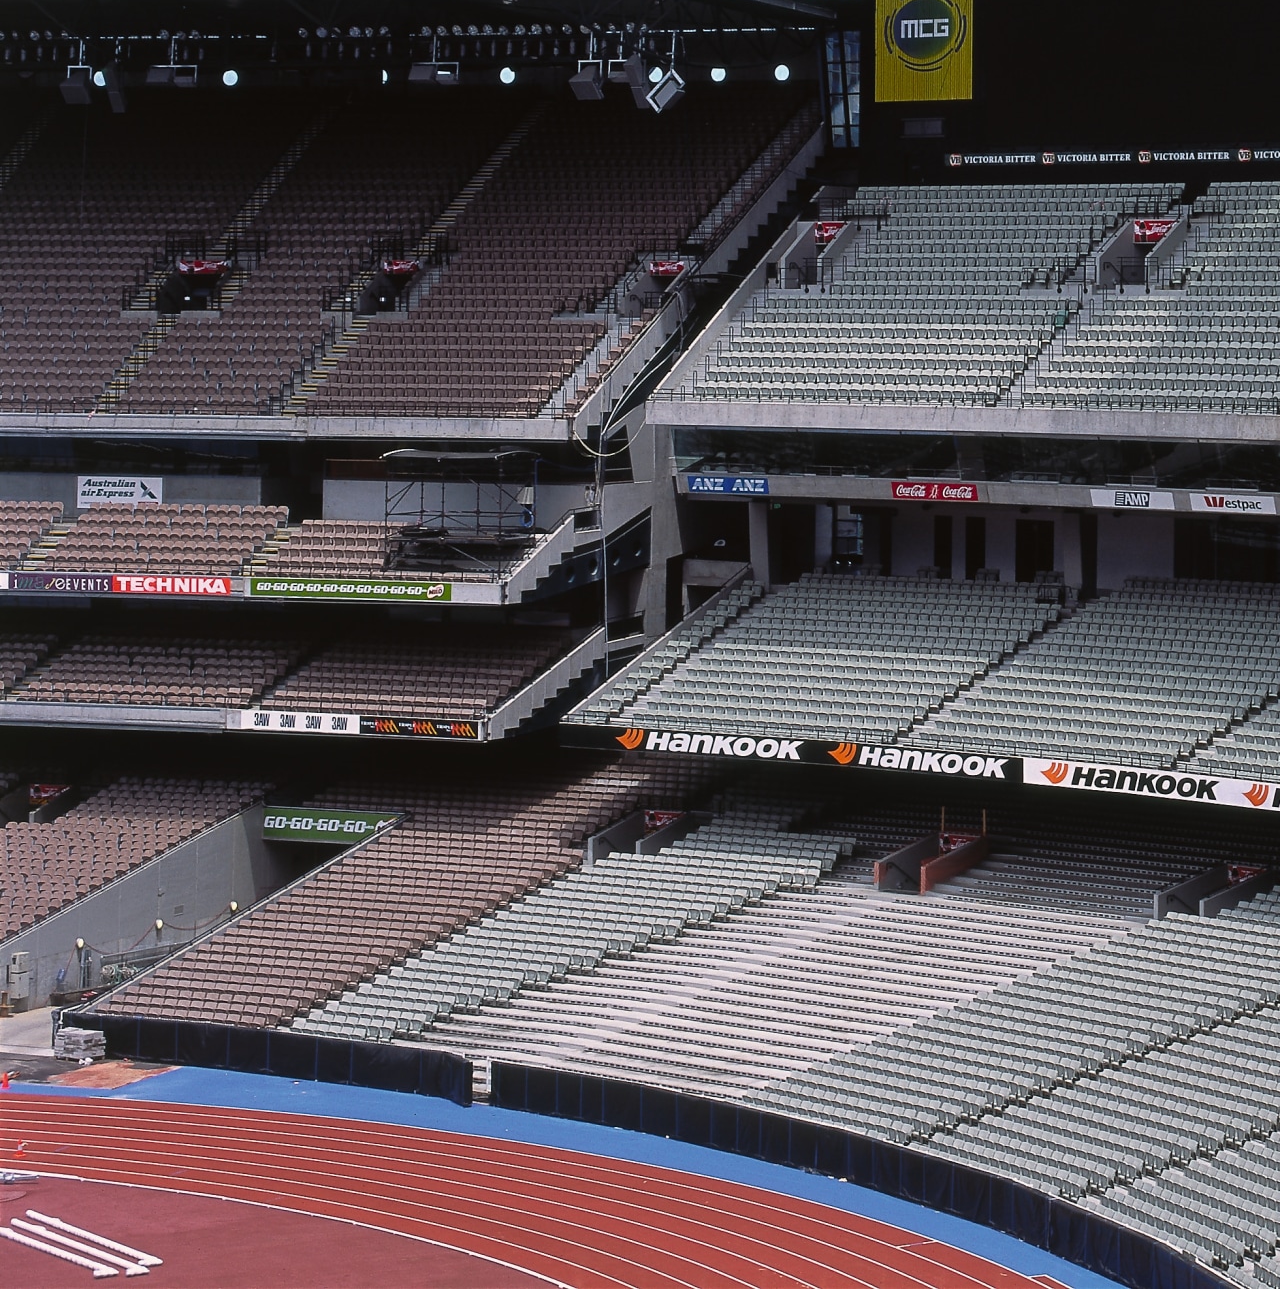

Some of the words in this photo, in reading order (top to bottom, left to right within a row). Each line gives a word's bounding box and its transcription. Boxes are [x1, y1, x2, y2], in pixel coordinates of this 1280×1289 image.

[900, 18, 950, 39] MCG
[1005, 155, 1036, 163] BITTER
[1057, 154, 1098, 162] VICTORIA
[1099, 154, 1131, 162] BITTER
[1153, 153, 1196, 161] VICTORIA
[1197, 152, 1230, 160] BITTER
[83, 478, 136, 488] Australian
[692, 477, 724, 490] ANZ
[732, 478, 765, 492] ANZ
[1124, 493, 1149, 507] AMP
[1203, 496, 1262, 511] Westpac
[117, 576, 229, 595] TECHNIKA
[254, 713, 270, 727] 3AW
[280, 714, 296, 728] 3AW
[306, 715, 322, 729] 3AW
[332, 716, 348, 731] 3AW
